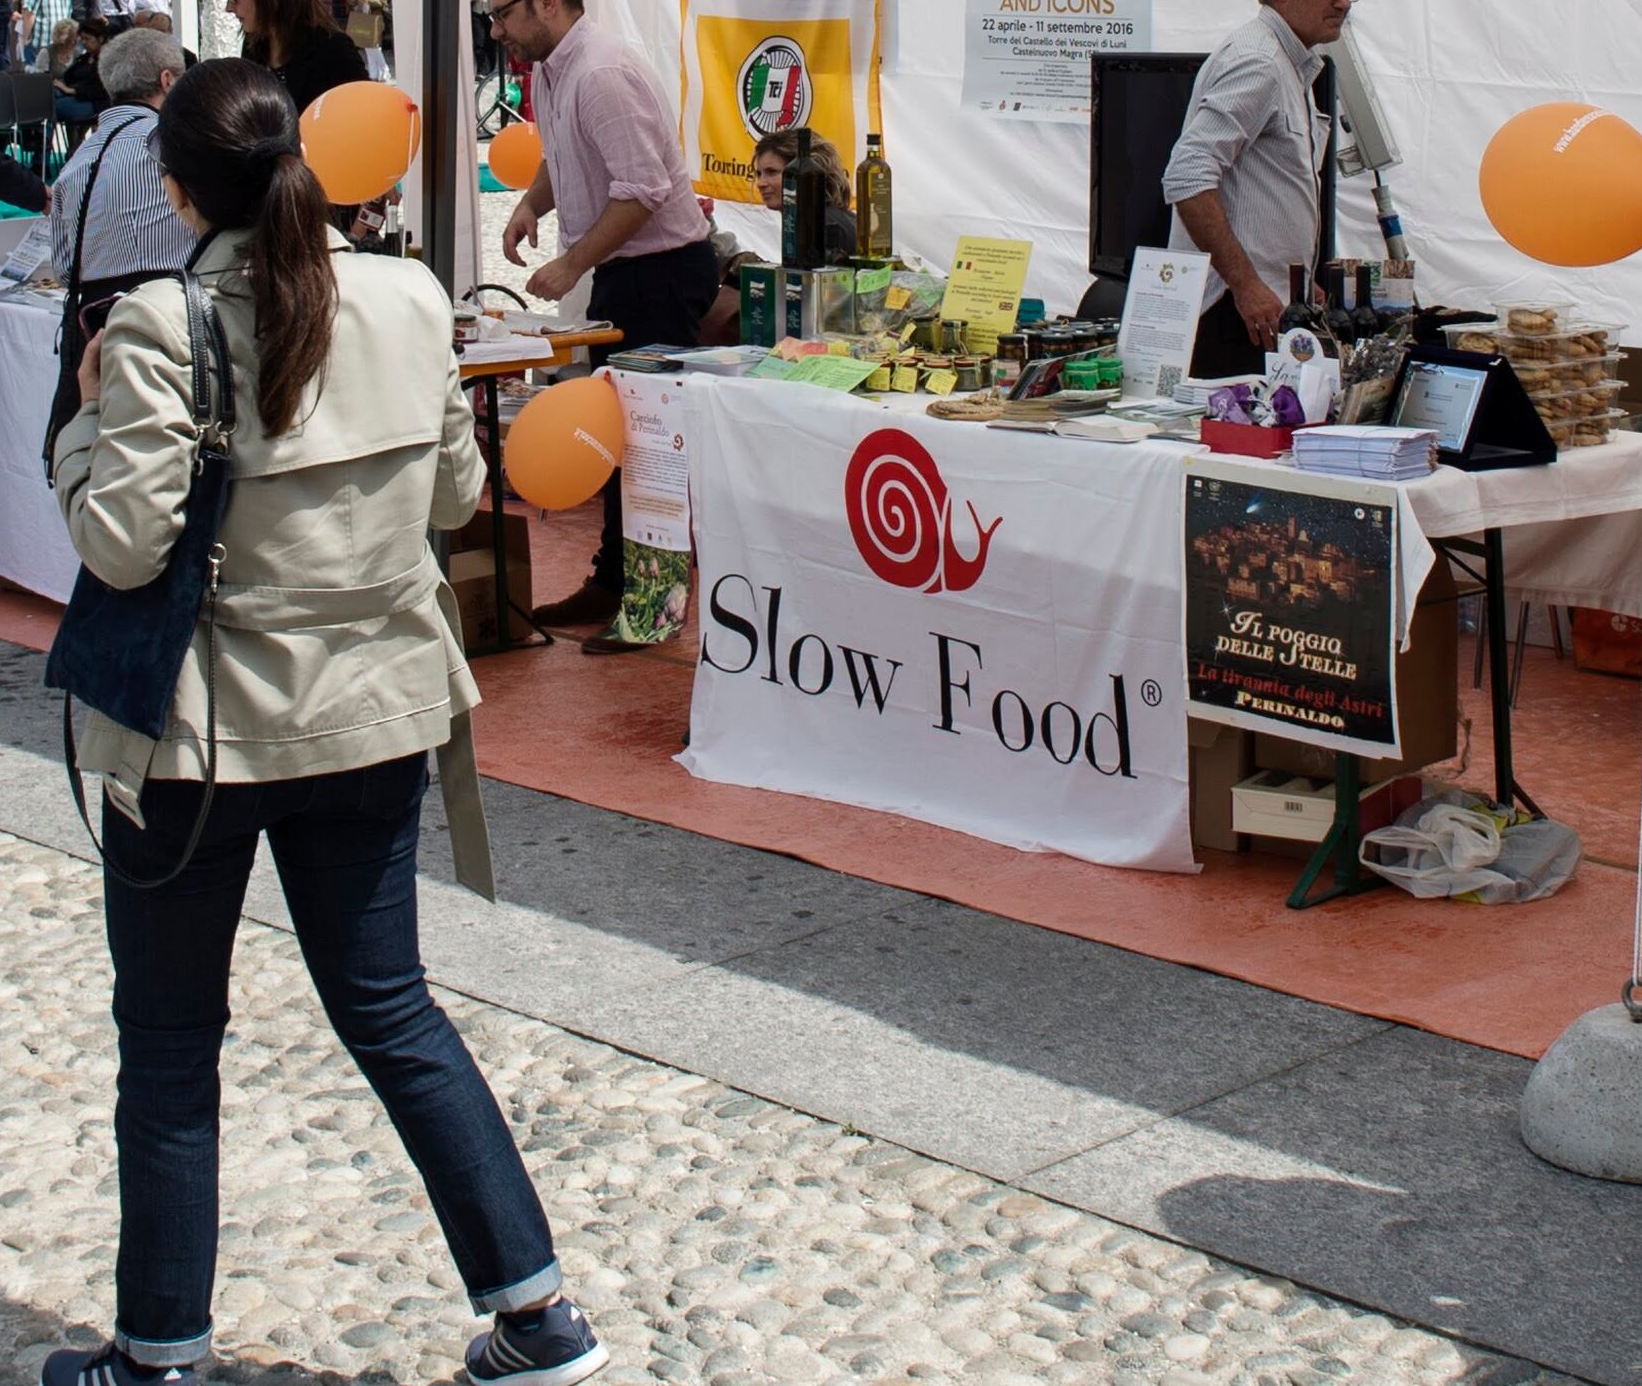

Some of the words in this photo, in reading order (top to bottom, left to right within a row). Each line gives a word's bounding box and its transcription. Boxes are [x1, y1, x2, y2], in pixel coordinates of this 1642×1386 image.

[982, 19, 995, 31] 22
[998, 19, 1026, 34] aprile
[1036, 22, 1044, 32] 11
[1047, 22, 1102, 35] settembre
[1106, 23, 1133, 35] 2016
[988, 35, 1008, 45] Torre
[1010, 36, 1021, 45] del
[1024, 36, 1053, 46] Castello
[1055, 37, 1066, 47] dei
[1069, 38, 1099, 48] Vescovi
[1101, 39, 1108, 48] di
[1110, 40, 1127, 49] Luni
[1013, 47, 1057, 58] Castelnuovo
[1060, 48, 1083, 61] Magra
[630, 410, 663, 425] Carciofo
[638, 424, 670, 438] Perinaldo
[701, 574, 903, 715] Slow
[1267, 621, 1342, 655] POGGIO
[1216, 635, 1274, 662] DELLE
[1279, 643, 1357, 681] STELLE
[1197, 663, 1218, 681] La
[1222, 667, 1290, 698] tirannia
[1294, 684, 1335, 707] degli
[1340, 696, 1383, 718] Astri
[1234, 691, 1345, 728] PERINALDO
